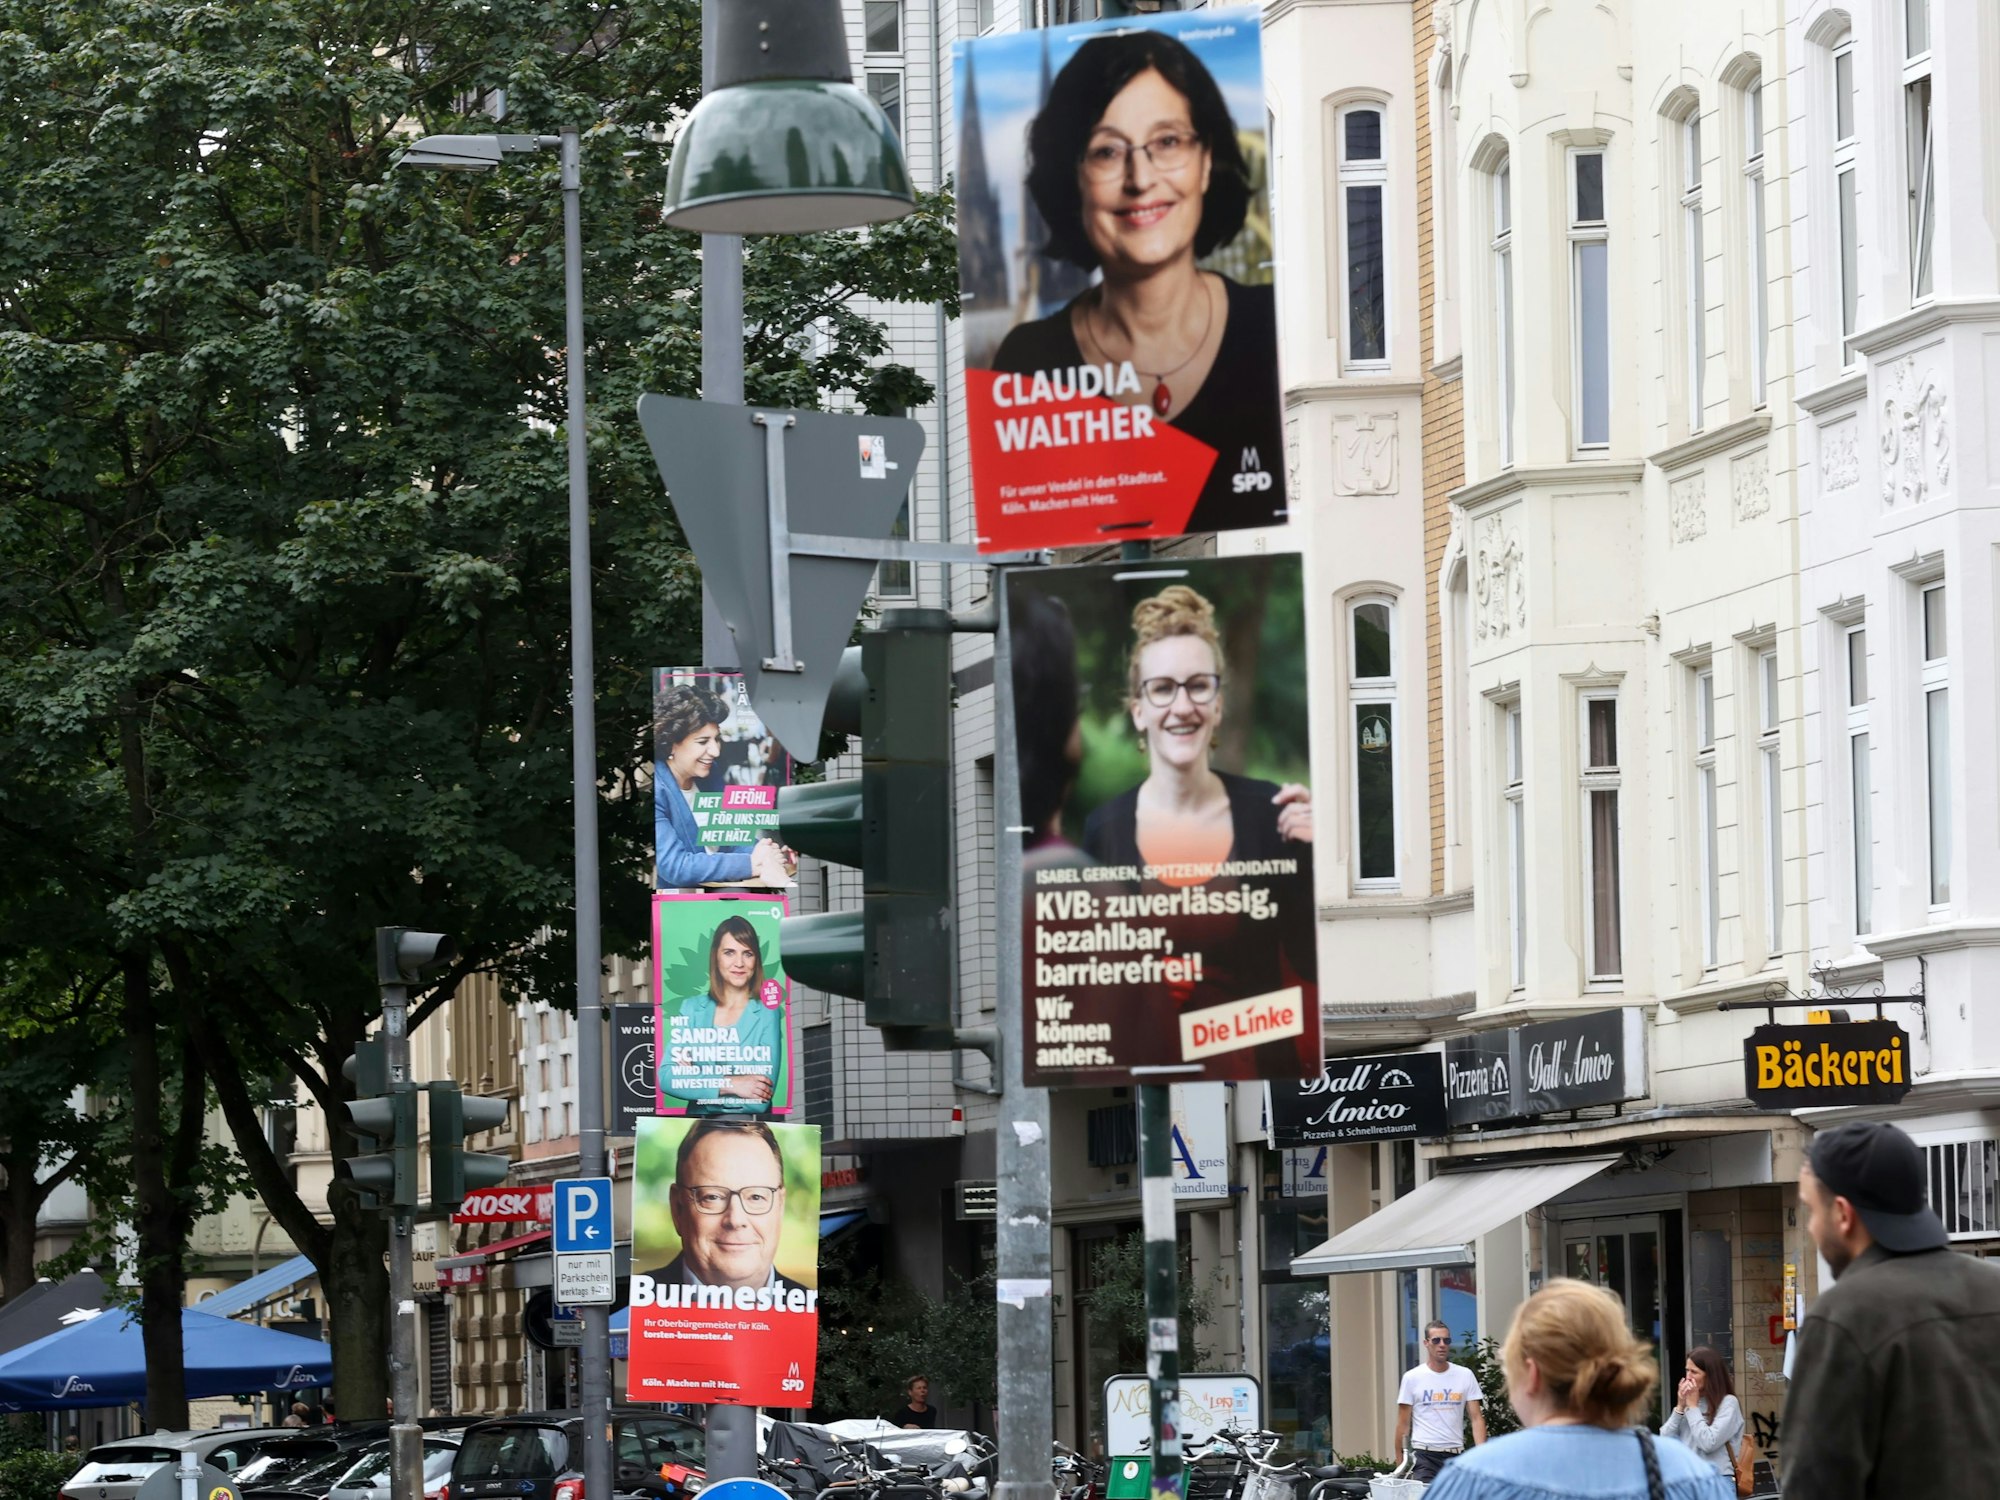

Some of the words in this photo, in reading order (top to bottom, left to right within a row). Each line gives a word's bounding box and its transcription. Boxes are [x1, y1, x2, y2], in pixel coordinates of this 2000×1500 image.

[992, 360, 1142, 408] CLAUDIA
[994, 404, 1155, 452] WALTHER
[1000, 485, 1017, 498] Für
[1018, 484, 1047, 497] unser
[1047, 477, 1082, 493] Veedel
[1084, 477, 1094, 489] in
[1096, 475, 1116, 488] den
[1118, 471, 1168, 487] Stadtrat.
[1232, 471, 1272, 493] SPD
[1001, 502, 1028, 515] Köln.
[1029, 498, 1069, 512] Machen
[1071, 495, 1089, 509] mit
[1090, 494, 1118, 507] Herz.
[698, 796, 721, 808] MET
[727, 788, 771, 805] JEFÖHL.
[711, 811, 733, 825] FÖR
[734, 813, 754, 825] UNS
[701, 830, 725, 842] MET
[725, 828, 752, 842] HÄTZ.
[1036, 868, 1080, 884] ISABEL
[1082, 865, 1141, 883] GERKEN,
[1143, 859, 1298, 880] SPITZENKANDIDATIN
[1036, 890, 1100, 921] KVB:
[1105, 883, 1279, 920] zuverlässig,
[1035, 922, 1174, 954] bezahlbar,
[1035, 953, 1204, 987] barrierefrei!
[1035, 994, 1074, 1020] Wir
[670, 1016, 689, 1026] MIT
[1036, 1021, 1112, 1043] können
[1191, 1017, 1230, 1048] Die
[1233, 1004, 1295, 1036] Linke
[670, 1028, 740, 1044] SANDRA
[670, 1046, 771, 1062] SCHNEELOCH
[1035, 1043, 1114, 1066] anders.
[1755, 1036, 1903, 1090] Bäckerei
[671, 1065, 700, 1075] WIRD
[702, 1065, 714, 1075] IN
[716, 1064, 732, 1075] DIE
[733, 1064, 773, 1075] ZUKUNFT
[1449, 1058, 1489, 1100] Pizzeria
[1528, 1039, 1566, 1093] Dall'
[1564, 1035, 1614, 1087] Amico
[671, 1078, 734, 1089] INVESTIERT.
[1306, 1096, 1411, 1126] Amico
[1303, 1130, 1335, 1140] Pizzeria
[1337, 1129, 1344, 1137] &
[1346, 1123, 1417, 1137] Schnellrestaurant
[455, 1193, 532, 1216] KIOSK
[567, 1186, 599, 1241] P
[411, 1252, 435, 1262] KAUF
[568, 1261, 582, 1269] nur
[587, 1259, 601, 1268] mit
[413, 1281, 436, 1290] KAUF
[561, 1273, 609, 1283] Parkschein
[560, 1286, 589, 1297] werktags
[630, 1274, 818, 1313] Burmester
[643, 1319, 656, 1327] Ihr
[657, 1319, 737, 1330] Oberbürgermeister
[738, 1321, 750, 1330] für
[751, 1322, 771, 1330] Köln.
[643, 1330, 734, 1341] torsten-burmester.de
[51, 1375, 95, 1399] Sion
[273, 1365, 318, 1389] Sion
[642, 1378, 665, 1387] Köln.
[666, 1379, 700, 1388] Machen
[701, 1380, 716, 1389] mit
[718, 1381, 740, 1390] Herz.
[781, 1379, 805, 1391] SPD
